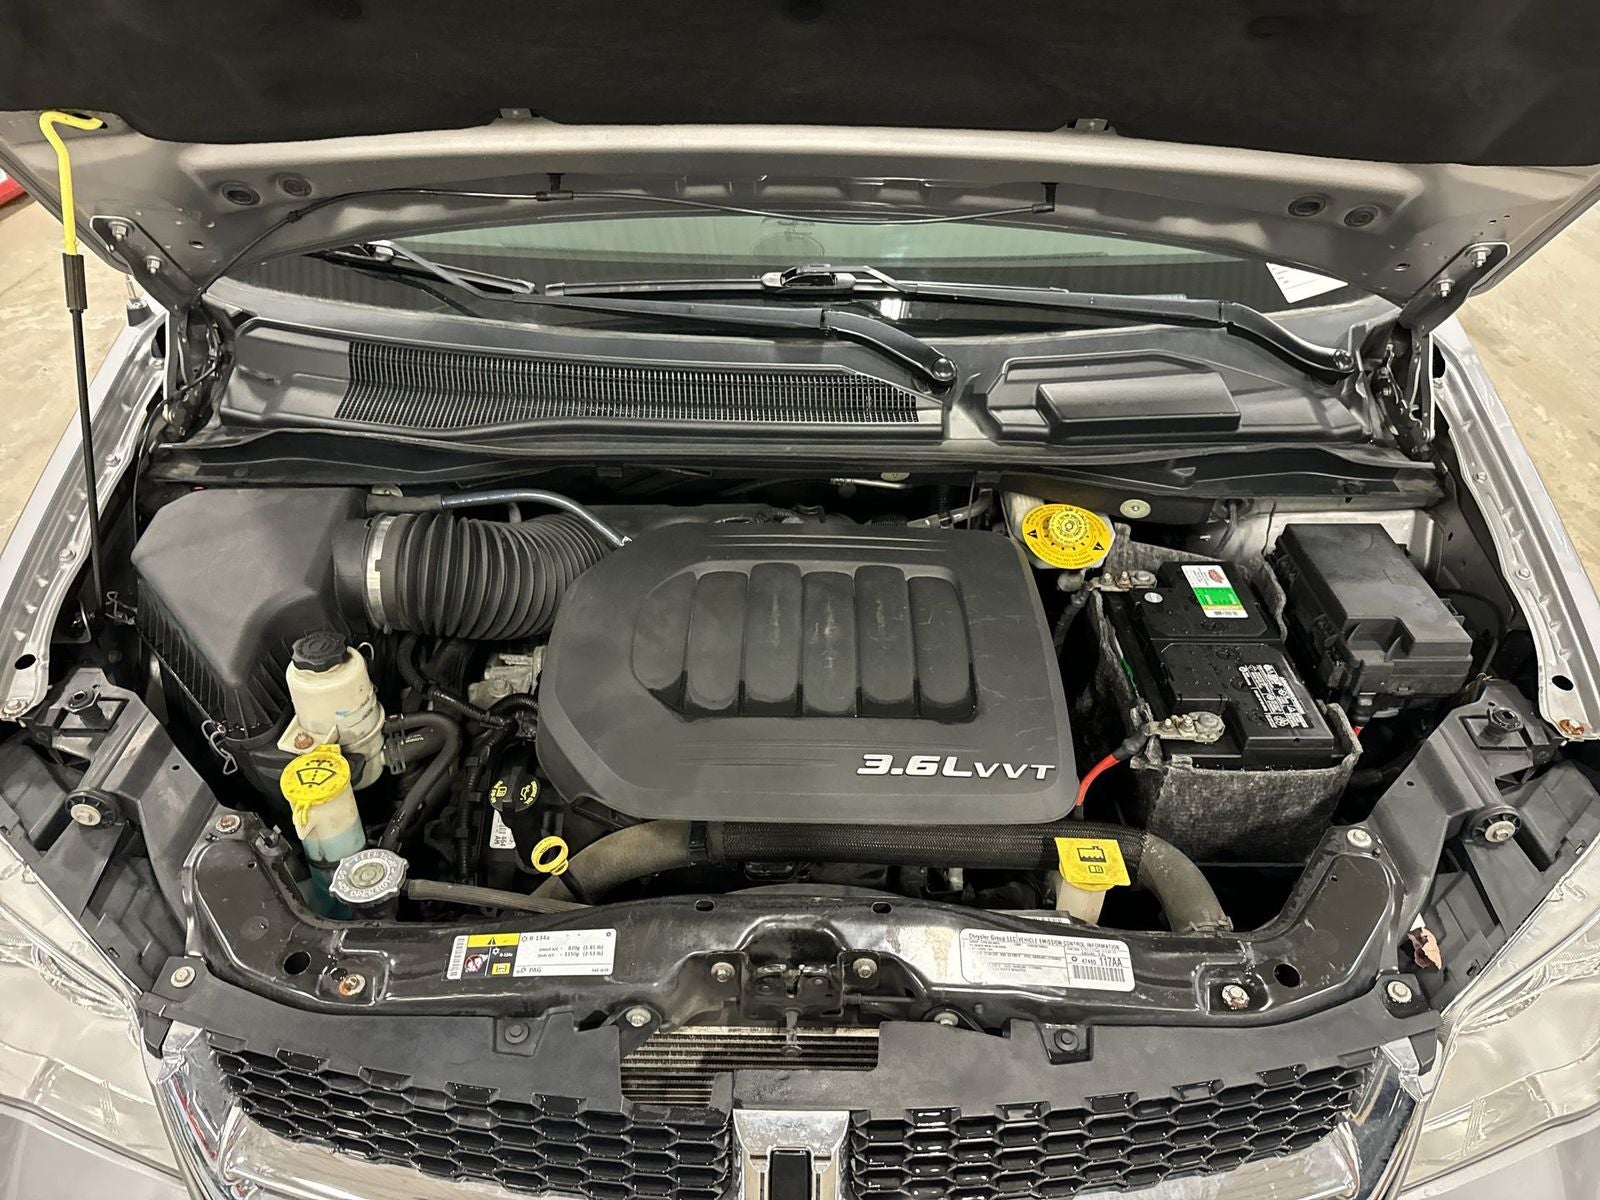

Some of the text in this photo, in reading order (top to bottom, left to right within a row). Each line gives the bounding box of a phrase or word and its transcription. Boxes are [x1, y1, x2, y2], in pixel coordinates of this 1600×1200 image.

[857, 754, 1056, 780] 3.6L VVT
[968, 933, 989, 941] Chrysler
[990, 934, 1006, 943] Group
[1099, 956, 1123, 967] 117AA
